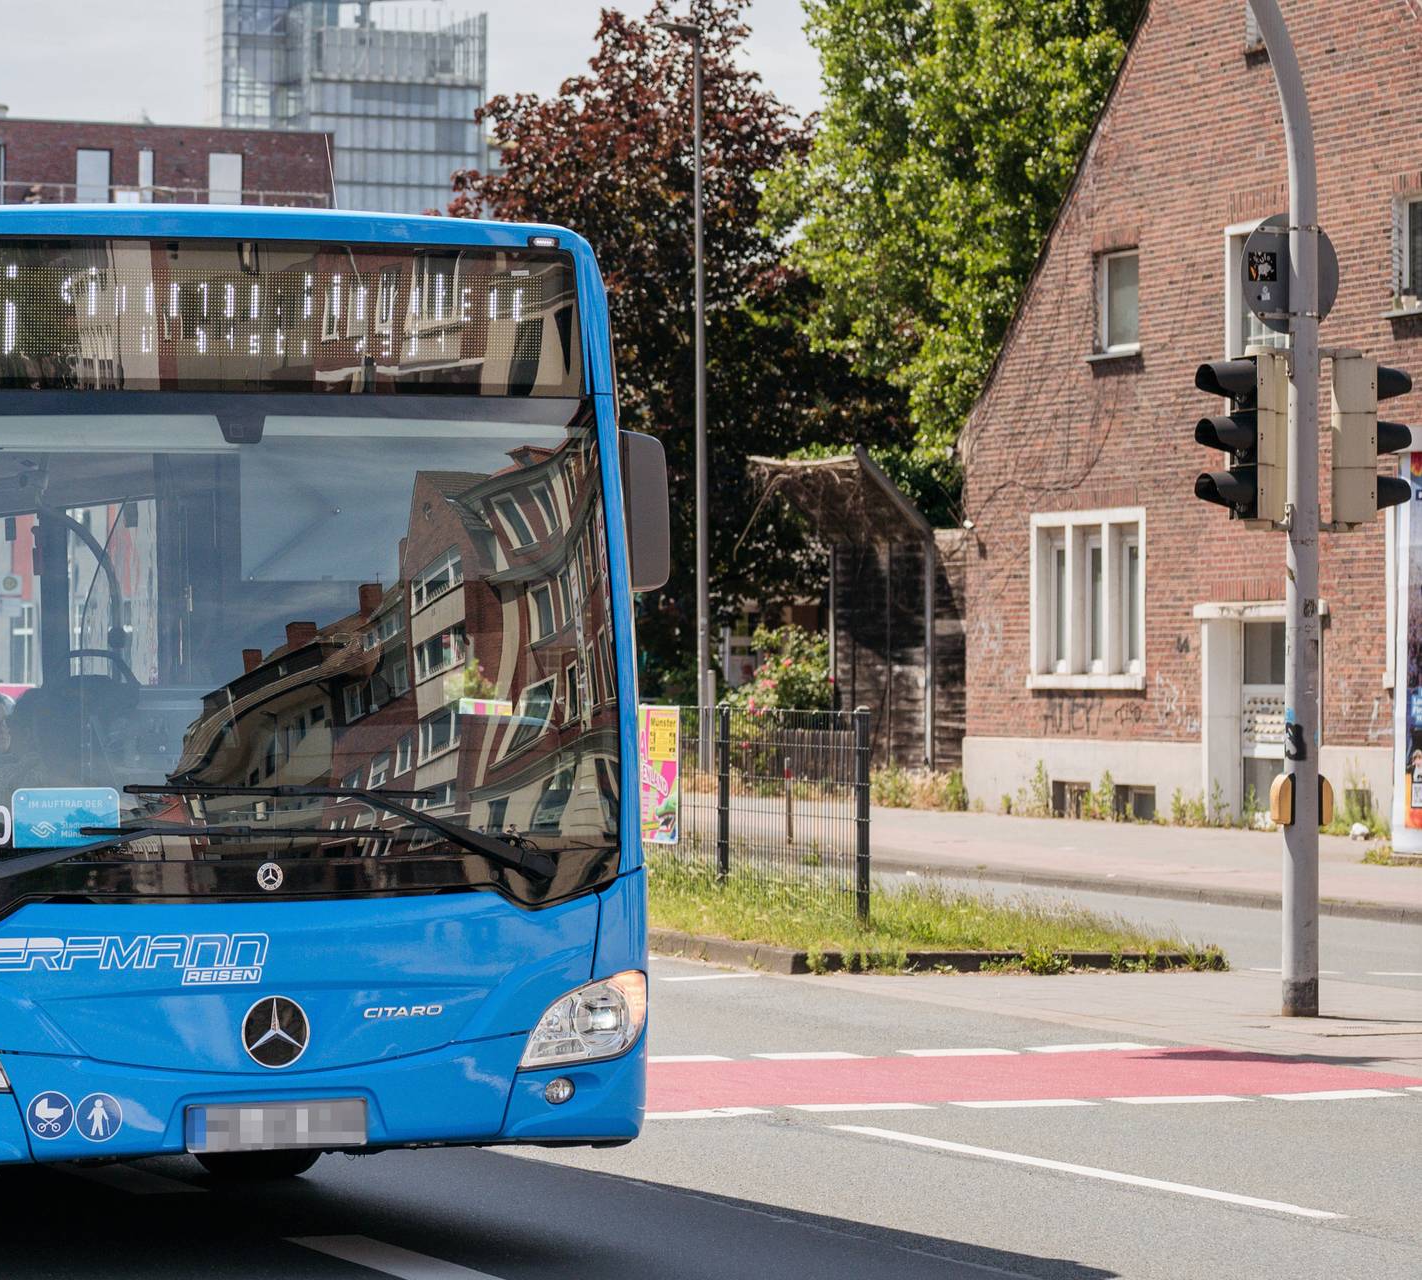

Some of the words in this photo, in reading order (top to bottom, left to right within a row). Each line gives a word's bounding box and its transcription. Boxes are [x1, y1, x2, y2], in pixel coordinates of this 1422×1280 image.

[28, 799, 40, 809] IM
[41, 799, 83, 809] AUFTRAG
[85, 799, 104, 809] DER
[186, 969, 259, 982] REISEN
[363, 1004, 444, 1020] CITARO
